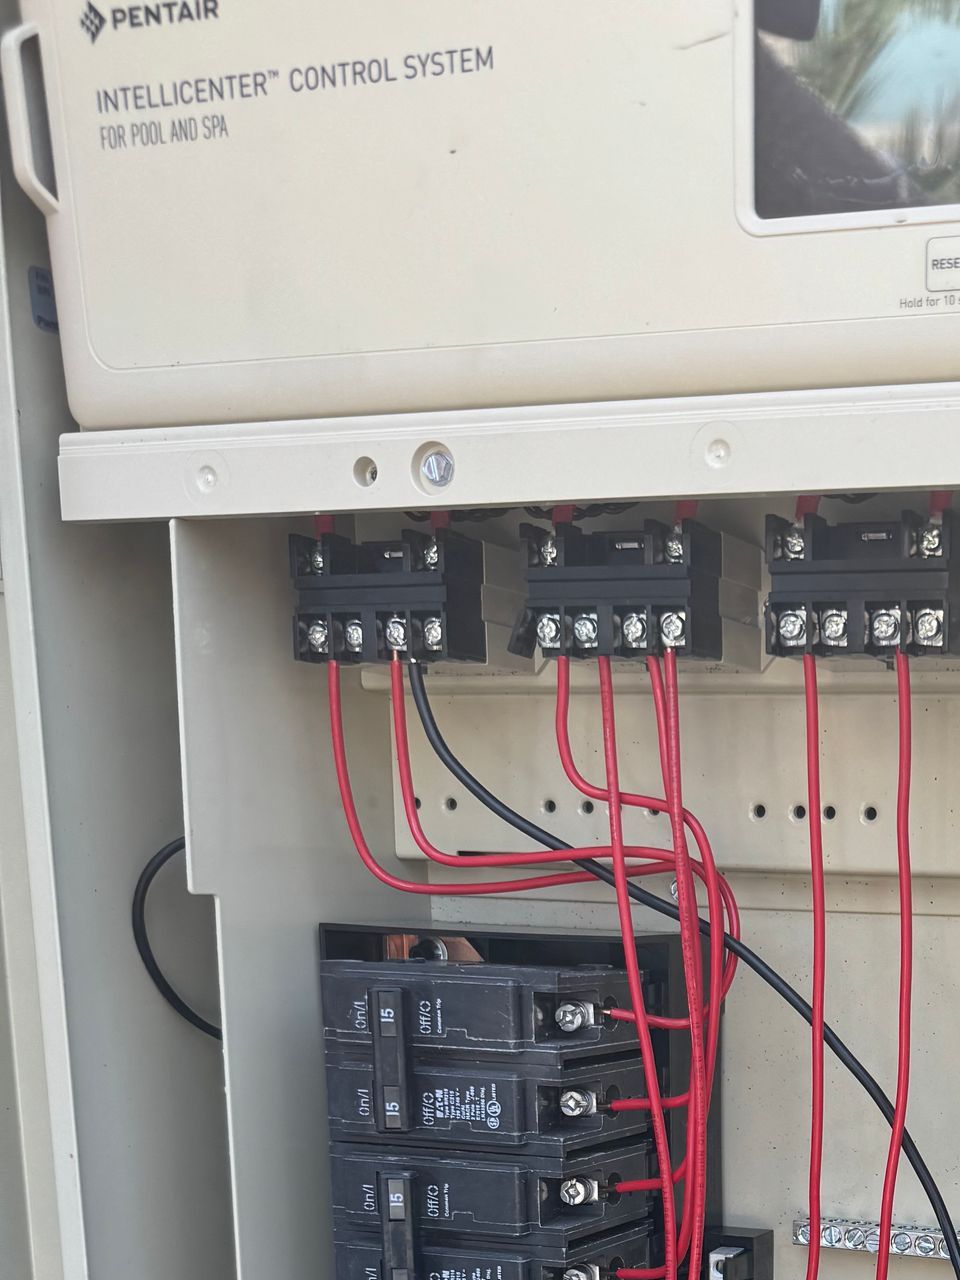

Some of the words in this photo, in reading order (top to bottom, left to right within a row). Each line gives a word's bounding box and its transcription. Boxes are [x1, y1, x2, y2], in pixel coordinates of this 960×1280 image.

[112, 0, 219, 29] PENTAIR
[289, 58, 397, 92] CONTROL
[404, 46, 494, 79] SYSTEM
[100, 124, 127, 150] FOR
[131, 120, 166, 147] POOL
[170, 117, 198, 143] AND
[202, 114, 229, 140] SPA
[900, 297, 923, 309] Hold
[925, 296, 940, 307] for
[943, 295, 955, 306] 10
[380, 1008, 394, 1022] 15
[385, 1102, 400, 1116] 15
[390, 1193, 404, 1206] 15
